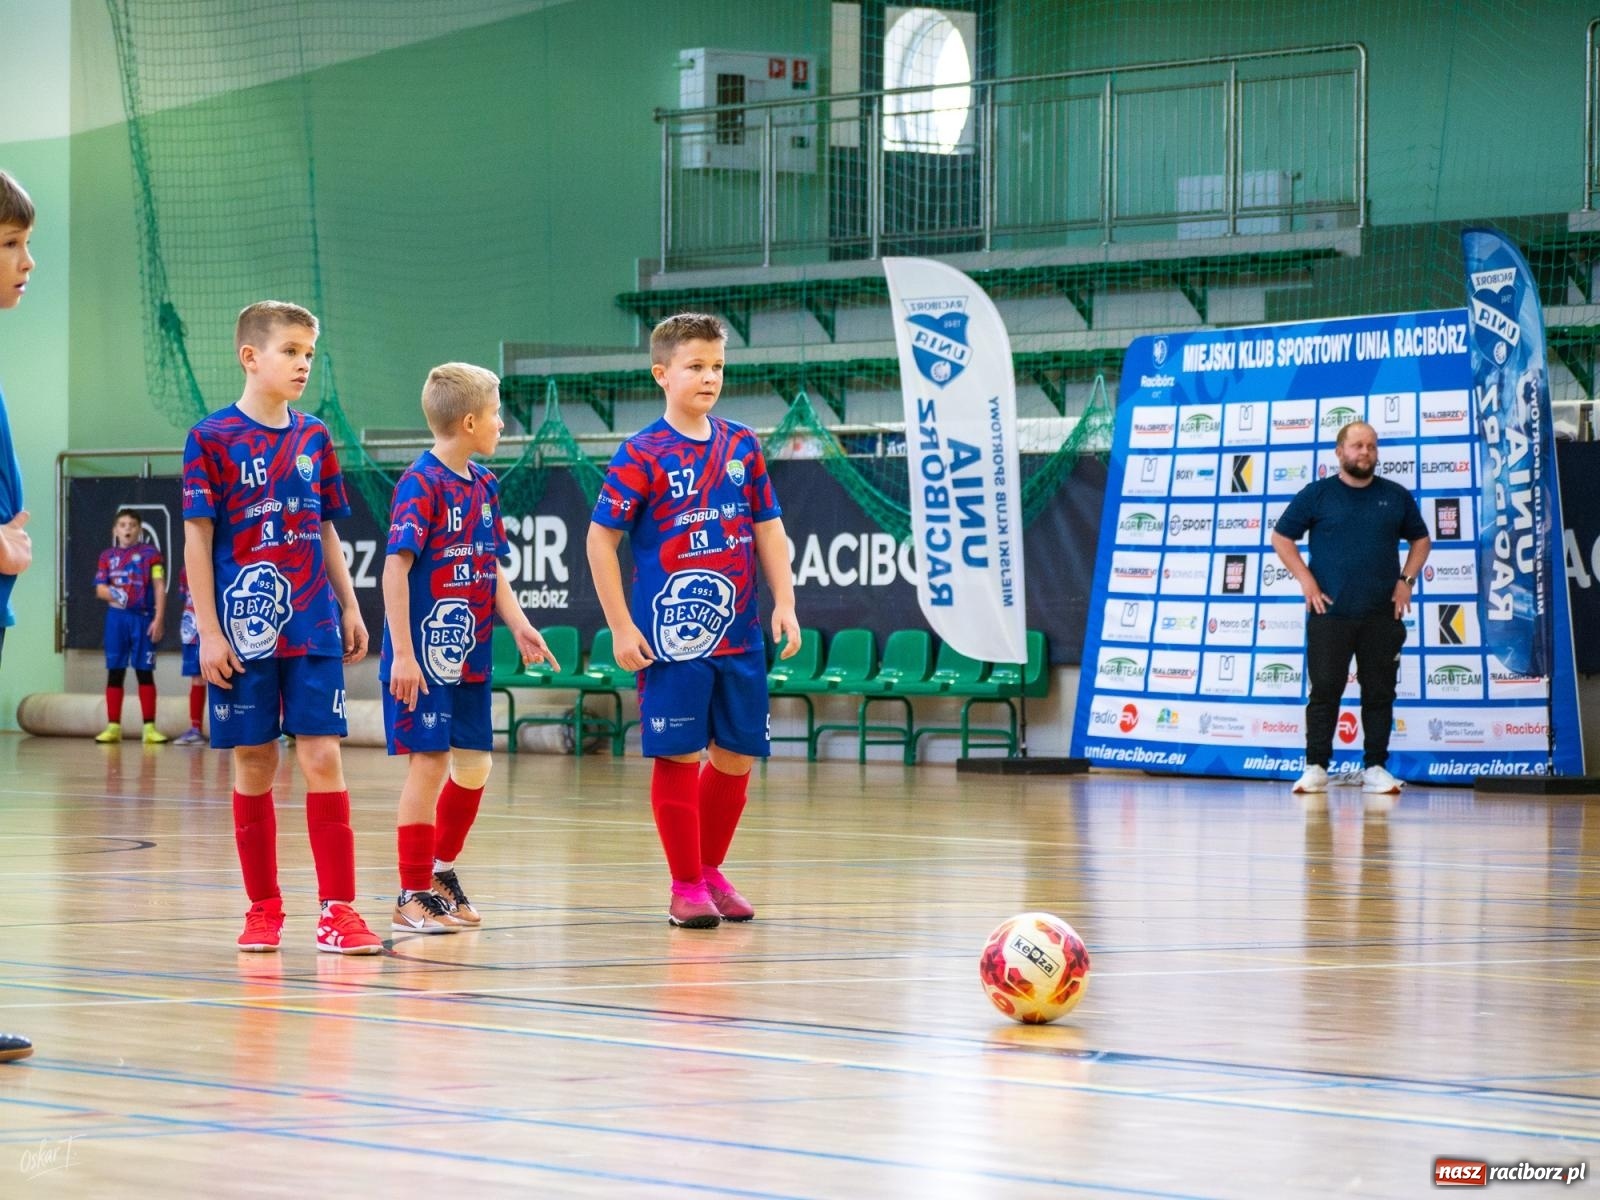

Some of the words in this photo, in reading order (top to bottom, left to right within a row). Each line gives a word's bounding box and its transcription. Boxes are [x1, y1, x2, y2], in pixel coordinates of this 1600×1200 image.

[1182, 342, 1235, 372] MIEJSKI
[1238, 339, 1275, 369] KLUB
[1277, 333, 1353, 367] SPORTOWY
[1355, 330, 1391, 361] UNIA
[1394, 319, 1468, 358] RACIBÓRZ
[240, 457, 268, 489] 46
[1382, 461, 1415, 474] SPORT
[1421, 461, 1470, 473] ELEKTROLEX
[1176, 469, 1194, 480] BOXY
[667, 469, 699, 499] 52
[447, 506, 462, 533] 16
[1181, 519, 1212, 531] SPORT
[1218, 518, 1260, 530] ELEKTROLEX
[1275, 569, 1299, 581] SPO
[1437, 567, 1460, 576] Marco
[692, 587, 713, 597] 1951
[663, 604, 723, 632] BESKID
[1090, 711, 1118, 725] radio
[1261, 721, 1299, 734] Racibórz
[1084, 744, 1187, 765] uniaraciborz.eu
